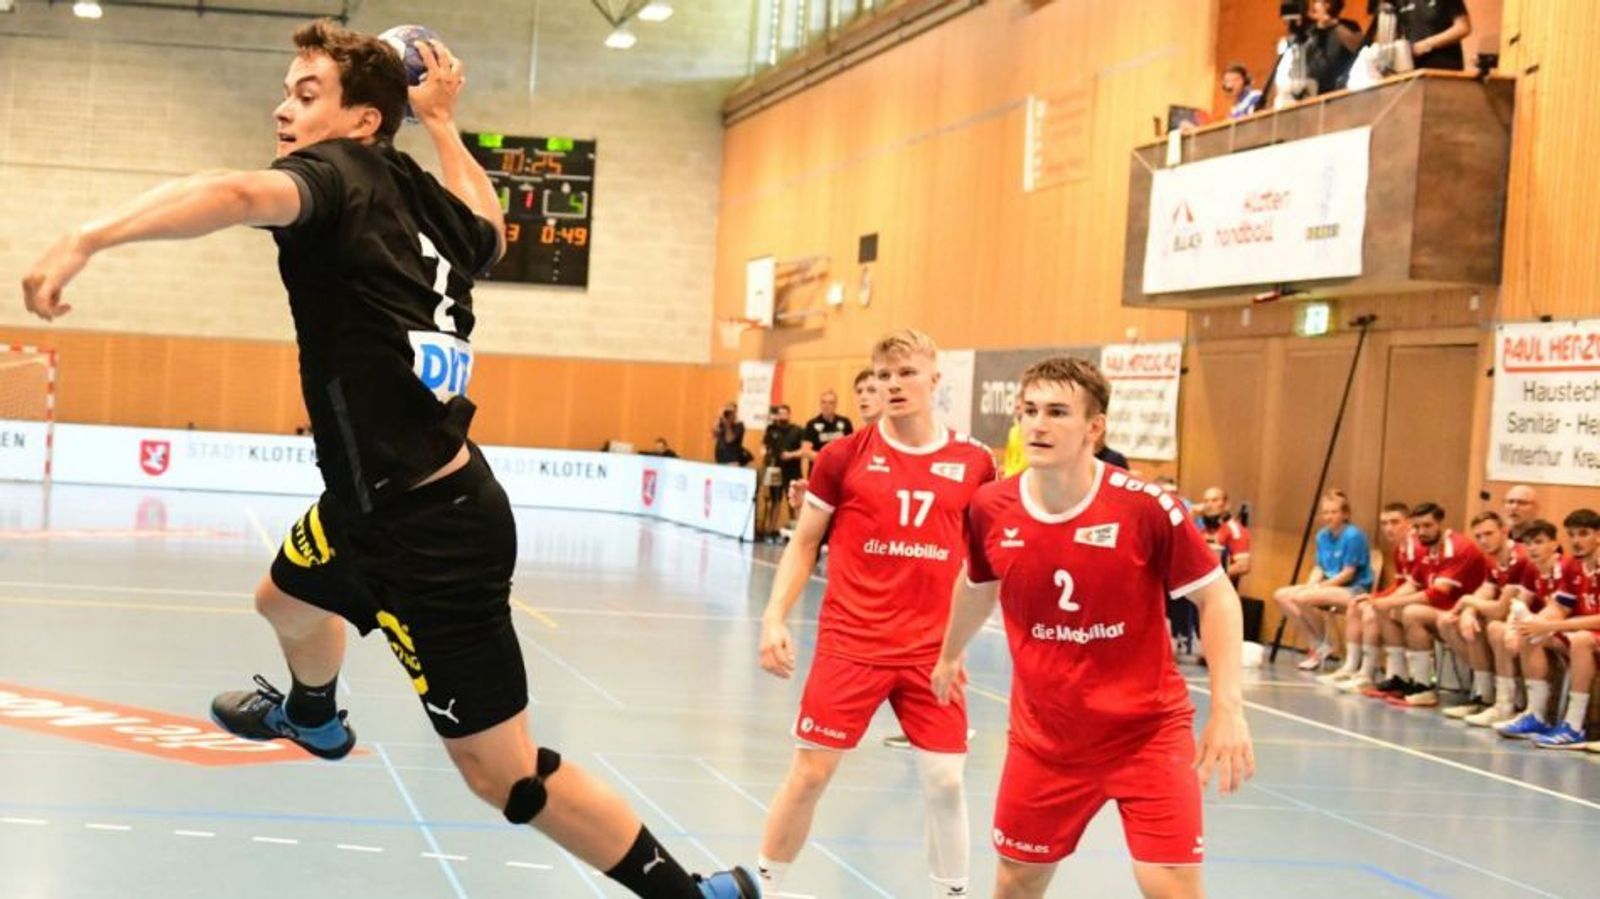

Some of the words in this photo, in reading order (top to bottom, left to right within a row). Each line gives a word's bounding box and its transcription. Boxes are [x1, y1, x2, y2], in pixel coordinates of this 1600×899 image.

[541, 226, 587, 246] 0:49
[896, 489, 935, 528] 17
[864, 539, 888, 555] die
[889, 541, 950, 561] Mobiliar
[1054, 569, 1080, 612] 2
[1032, 622, 1055, 640] die
[1055, 621, 1126, 644] Mobiliar
